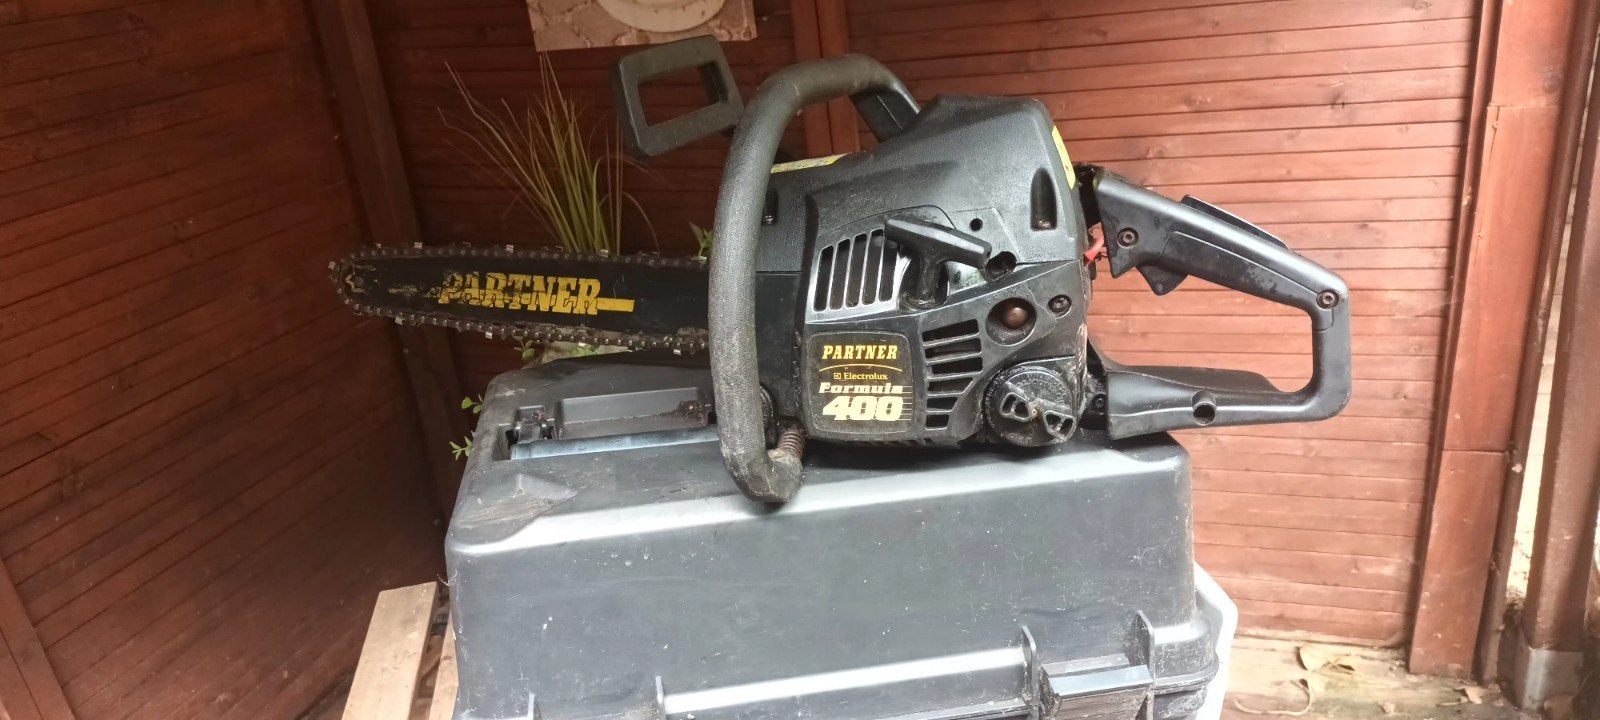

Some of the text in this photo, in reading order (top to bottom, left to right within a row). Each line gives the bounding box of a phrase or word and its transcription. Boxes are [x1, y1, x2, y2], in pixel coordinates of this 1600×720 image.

[438, 271, 601, 315] PARTNER
[822, 344, 898, 360] PARTNER
[844, 372, 888, 380] Electrolux
[819, 382, 903, 395] Formula
[822, 395, 904, 421] 400
